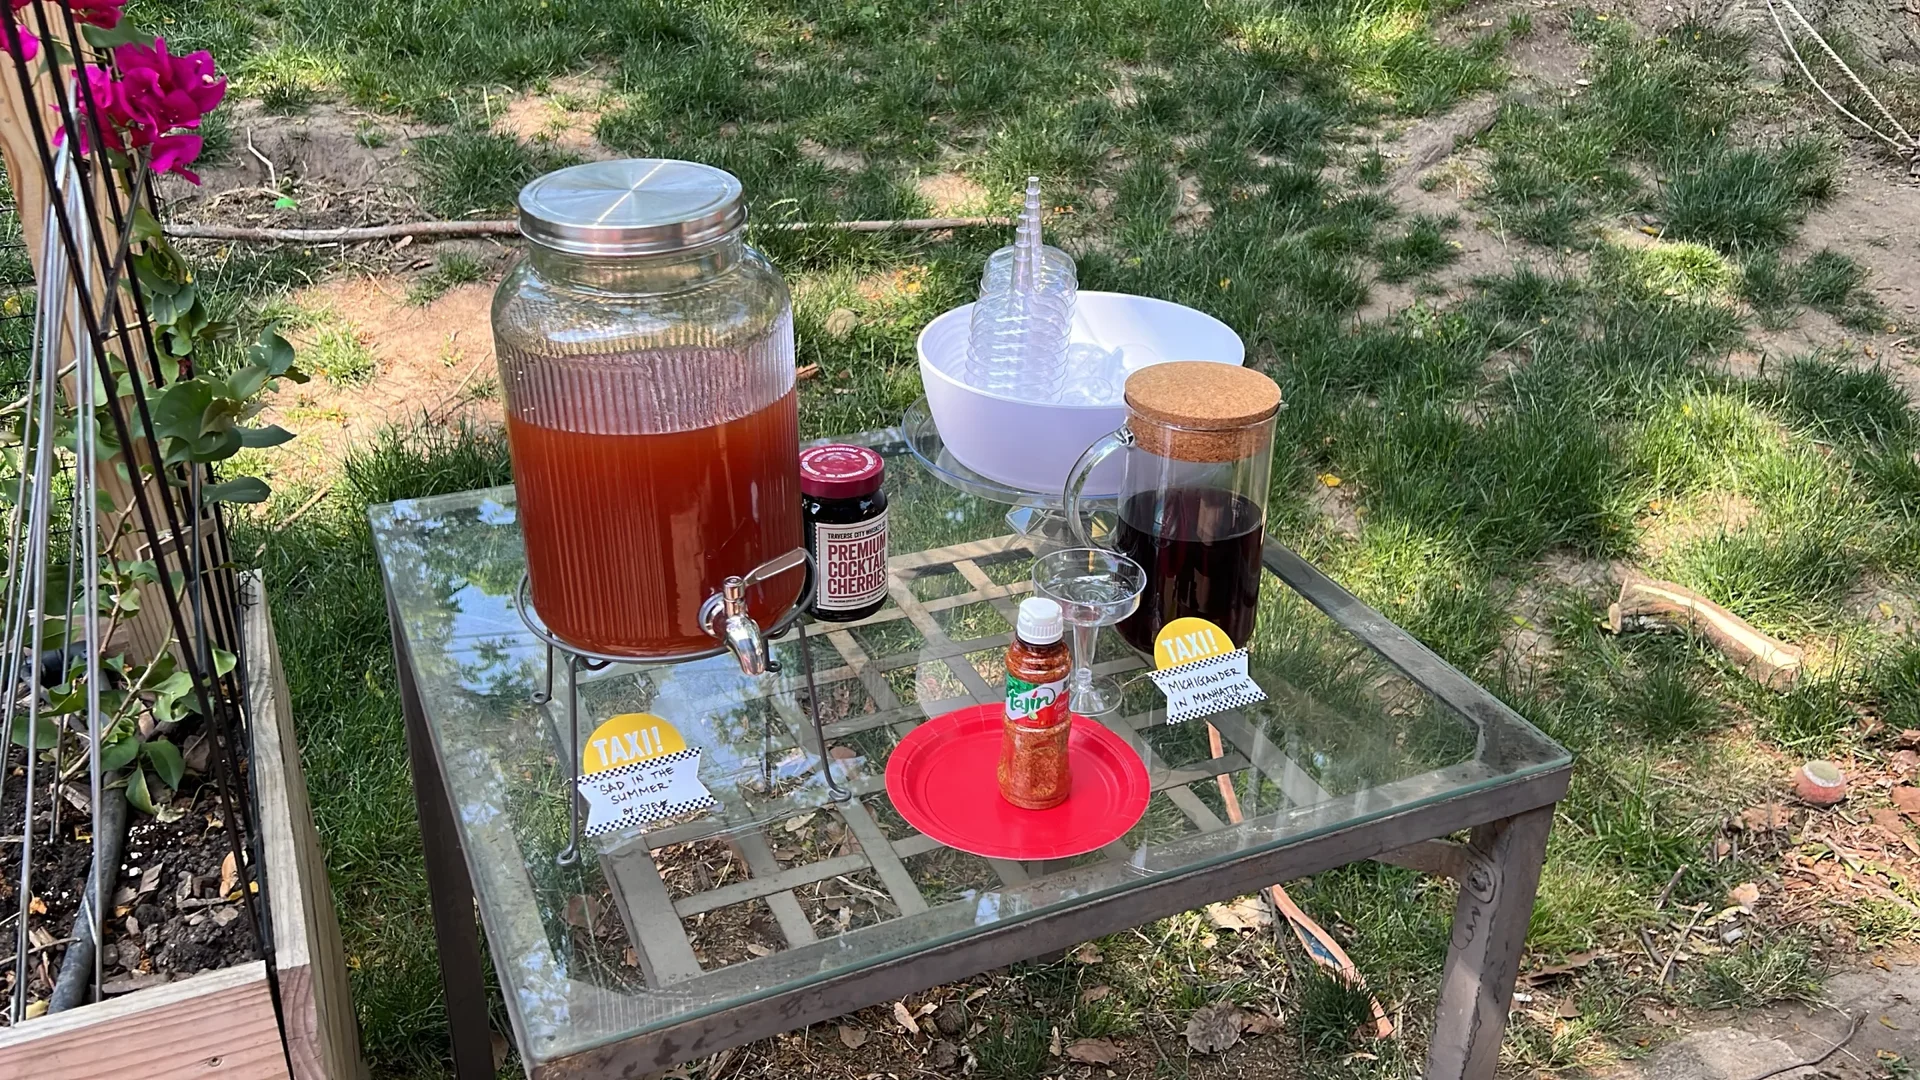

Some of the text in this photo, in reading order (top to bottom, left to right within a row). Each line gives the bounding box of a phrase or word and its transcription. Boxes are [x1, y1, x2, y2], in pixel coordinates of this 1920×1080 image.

[828, 531, 886, 560] PREMIUM
[828, 549, 886, 578] COCKTAIL
[828, 564, 887, 594] CHERRIES
[1161, 628, 1219, 664] TAXI!
[1174, 697, 1188, 710] IN
[592, 726, 663, 767] TAXI!
[631, 774, 644, 785] IN
[651, 767, 674, 779] THE
